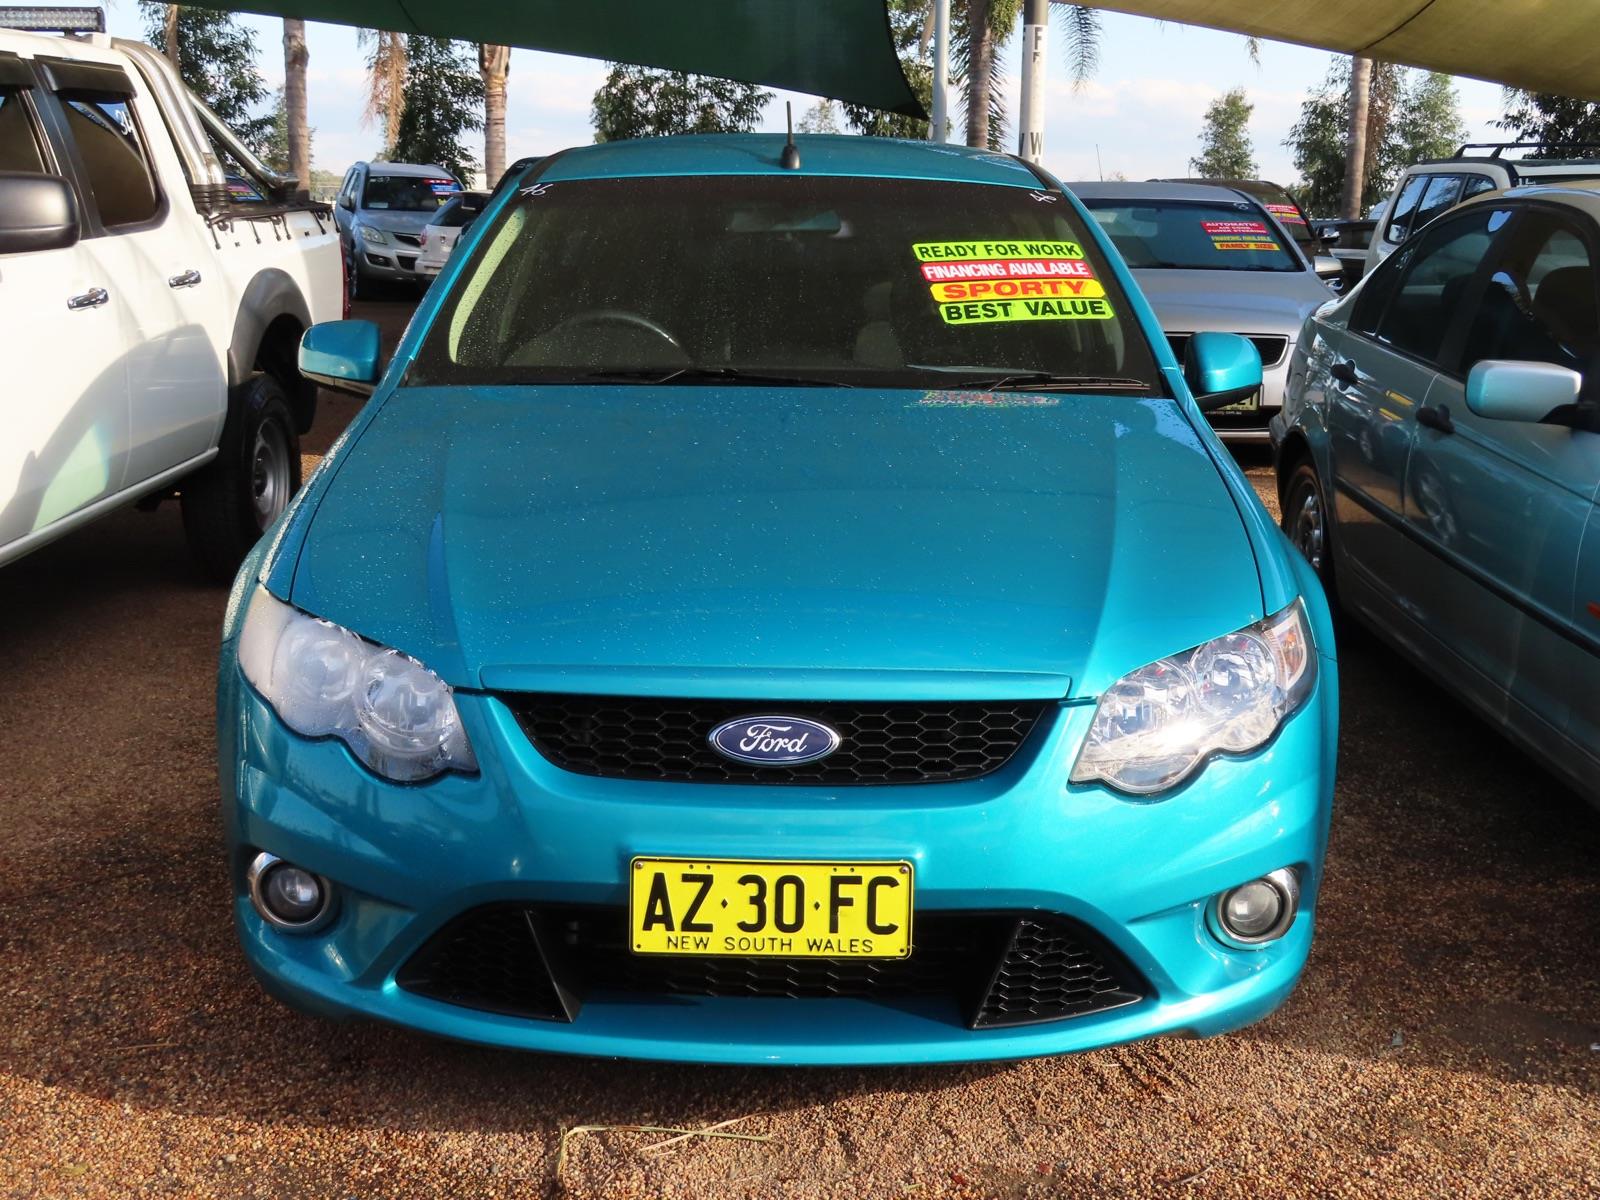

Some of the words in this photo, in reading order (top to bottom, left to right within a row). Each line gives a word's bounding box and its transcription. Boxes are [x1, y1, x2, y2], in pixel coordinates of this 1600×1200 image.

[918, 244, 977, 258] READY
[984, 244, 1021, 256] FOR
[1024, 244, 1081, 257] WORK
[923, 263, 1004, 280] FINANCING
[1010, 262, 1089, 277] AVAILABLE
[943, 281, 1084, 299] SPORTY
[945, 302, 1012, 321] BEST
[1024, 300, 1106, 316] VALUE
[739, 723, 807, 752] Ford
[667, 935, 710, 950] NEW
[725, 937, 792, 952] SOUTH
[807, 938, 874, 953] WALES
